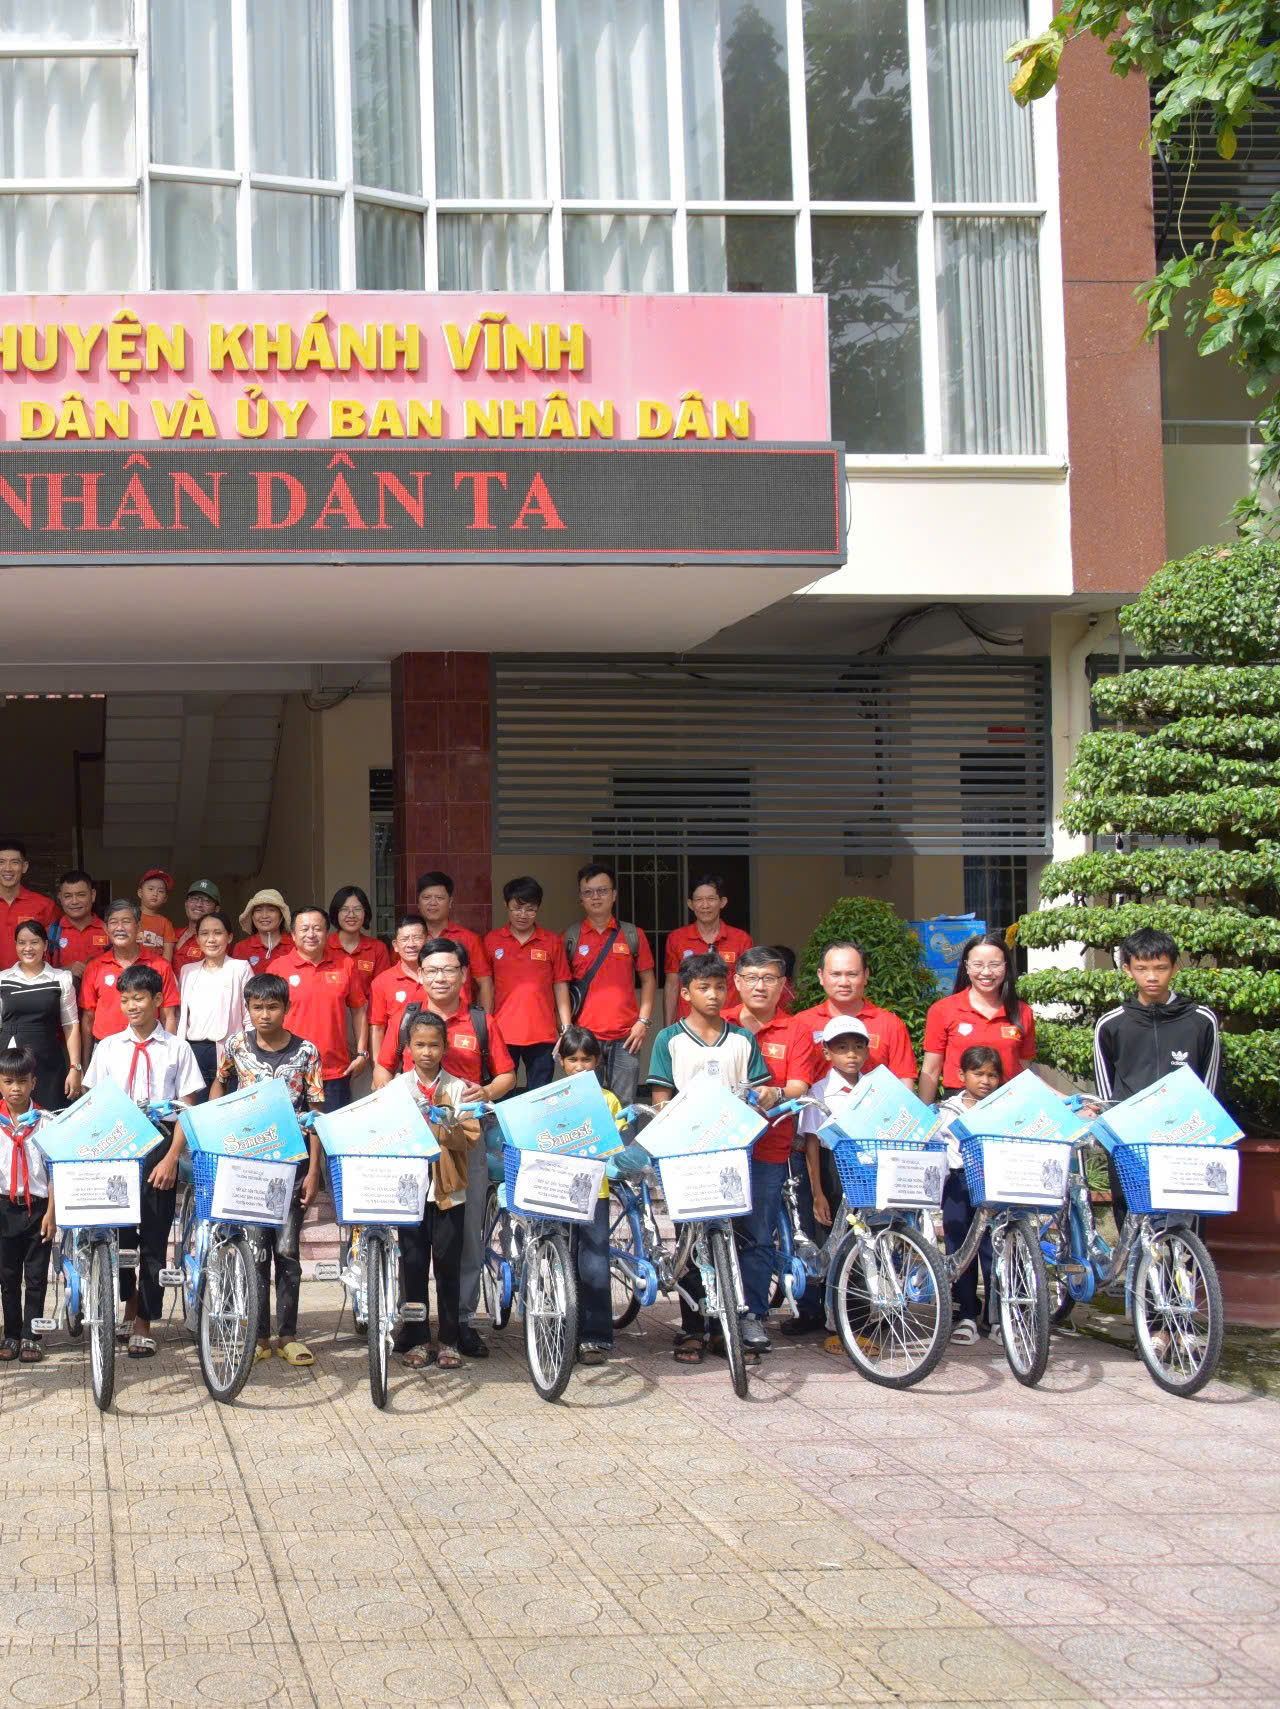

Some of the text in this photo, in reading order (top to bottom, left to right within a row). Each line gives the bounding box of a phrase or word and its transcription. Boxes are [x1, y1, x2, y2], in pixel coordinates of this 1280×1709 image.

[209, 311, 421, 373] KHÁNH
[440, 311, 586, 373] VĨNH
[20, 391, 130, 440] DÂN
[149, 390, 218, 439] VÀ
[235, 384, 310, 439] ỦY
[330, 399, 443, 439] BAN
[465, 390, 615, 440] NHÂN
[636, 390, 752, 440] DÂN
[249, 453, 433, 530] DÂN
[454, 470, 569, 530] TA
[222, 1122, 279, 1154] Sanest
[536, 1117, 593, 1151] Sanest
